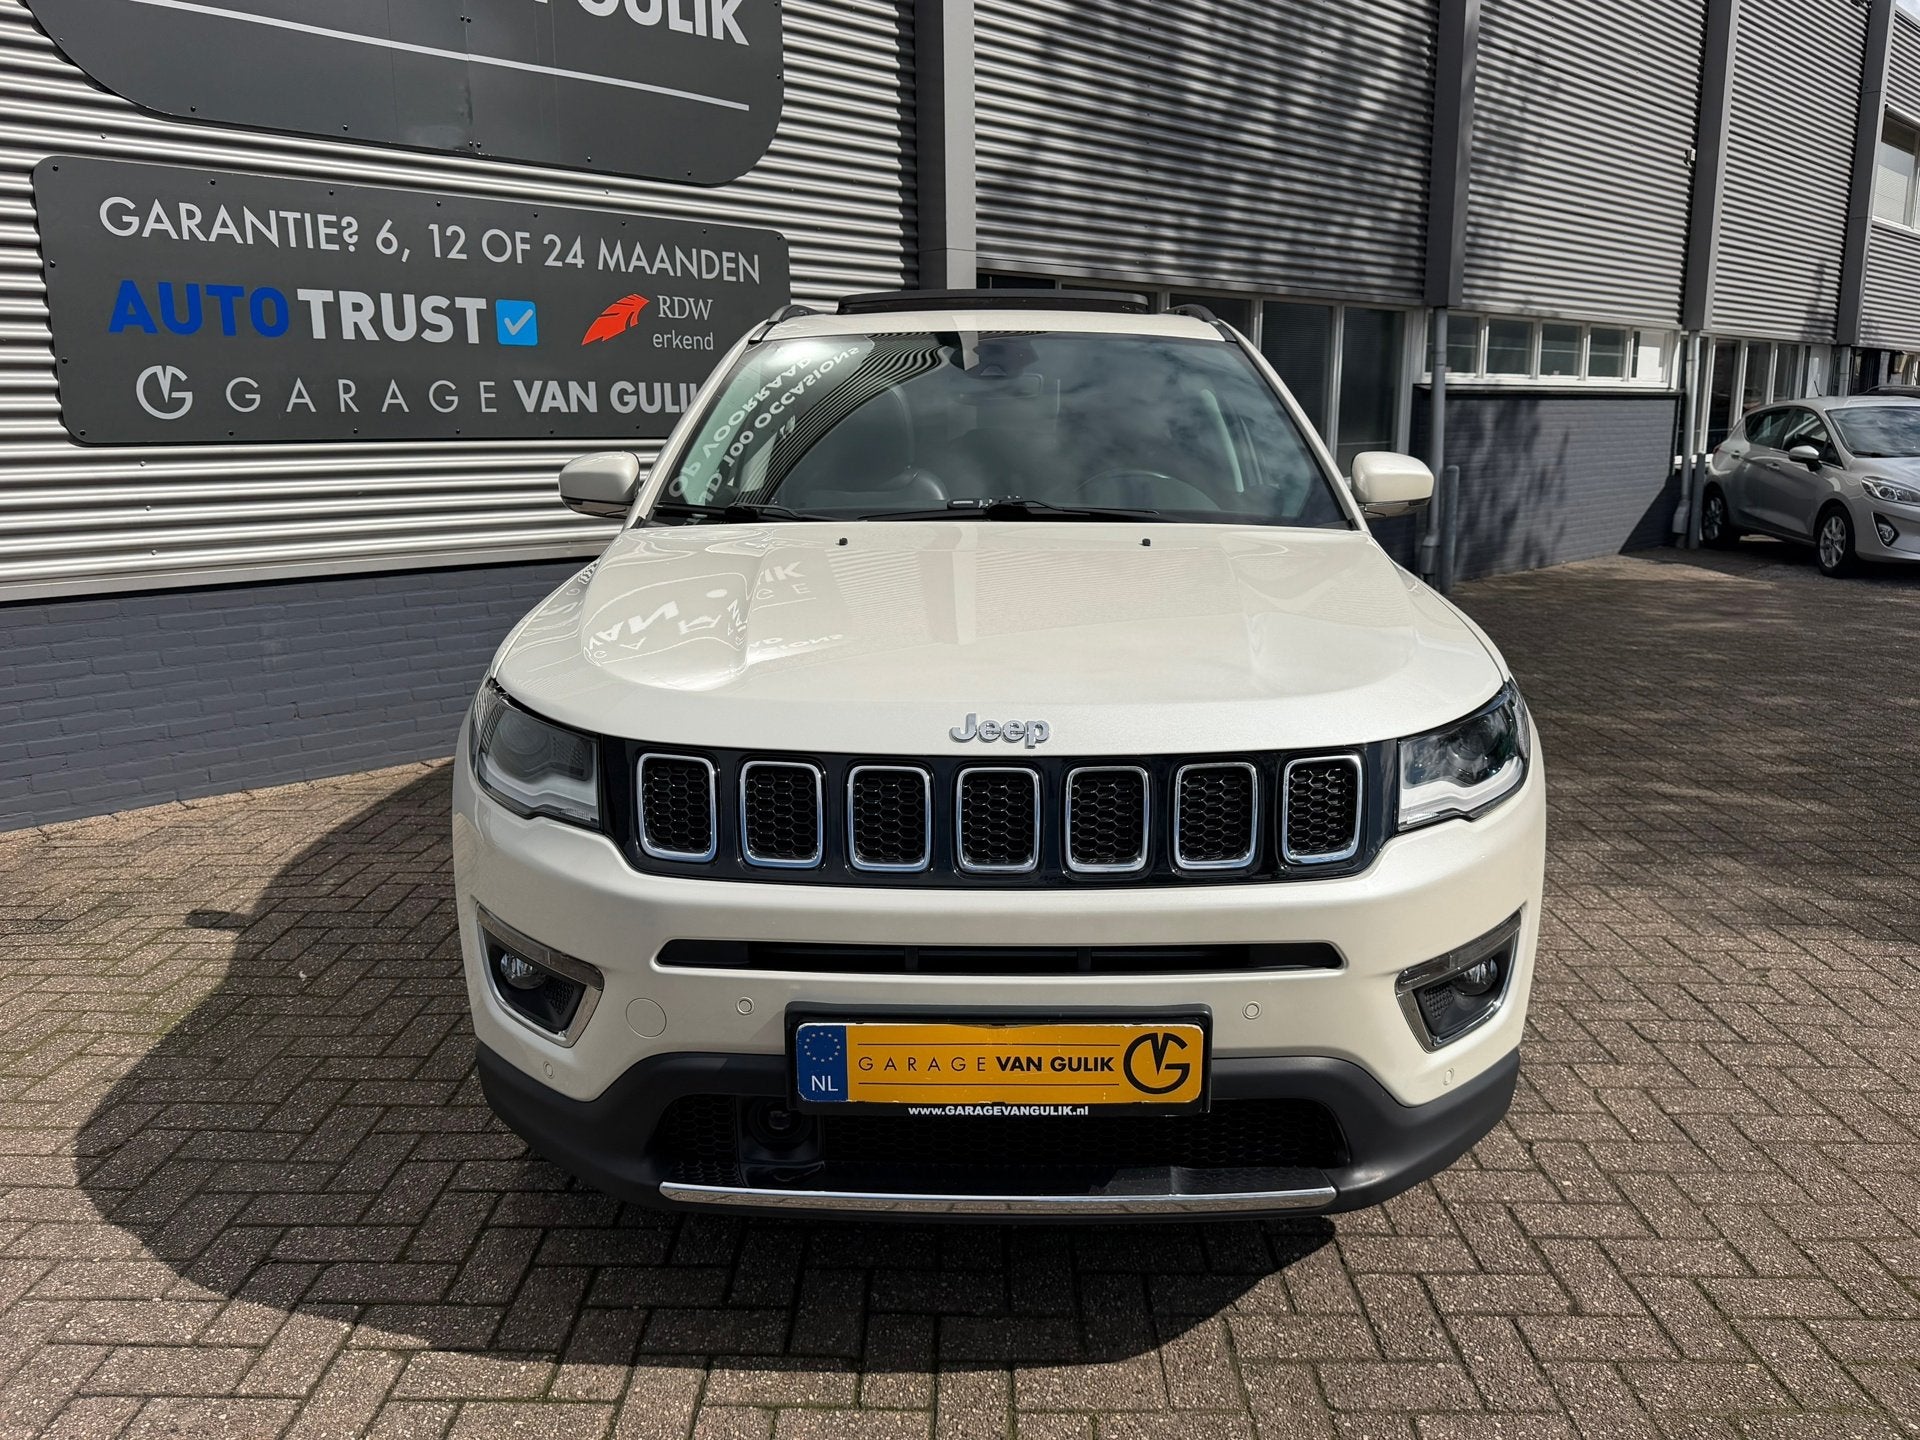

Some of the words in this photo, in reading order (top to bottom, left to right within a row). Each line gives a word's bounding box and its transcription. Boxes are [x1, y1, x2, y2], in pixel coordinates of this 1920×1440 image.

[100, 196, 359, 252] GARANTIE?
[376, 219, 410, 263] 6,
[428, 224, 468, 260] 12
[481, 228, 531, 264] OF
[544, 233, 585, 269] 24
[597, 237, 760, 285] MAANDEN
[656, 295, 713, 321] RDW
[652, 330, 714, 350] erkend
[225, 376, 497, 414] GARAGE
[513, 380, 598, 413] VAN
[949, 712, 1050, 750] Jeep
[858, 1056, 986, 1073] GARAGE
[995, 1056, 1043, 1072] VAN
[1050, 1056, 1115, 1072] GULIK
[811, 1076, 839, 1092] NL
[907, 1105, 1089, 1116] www.GARAGEVANGULIK.nl
